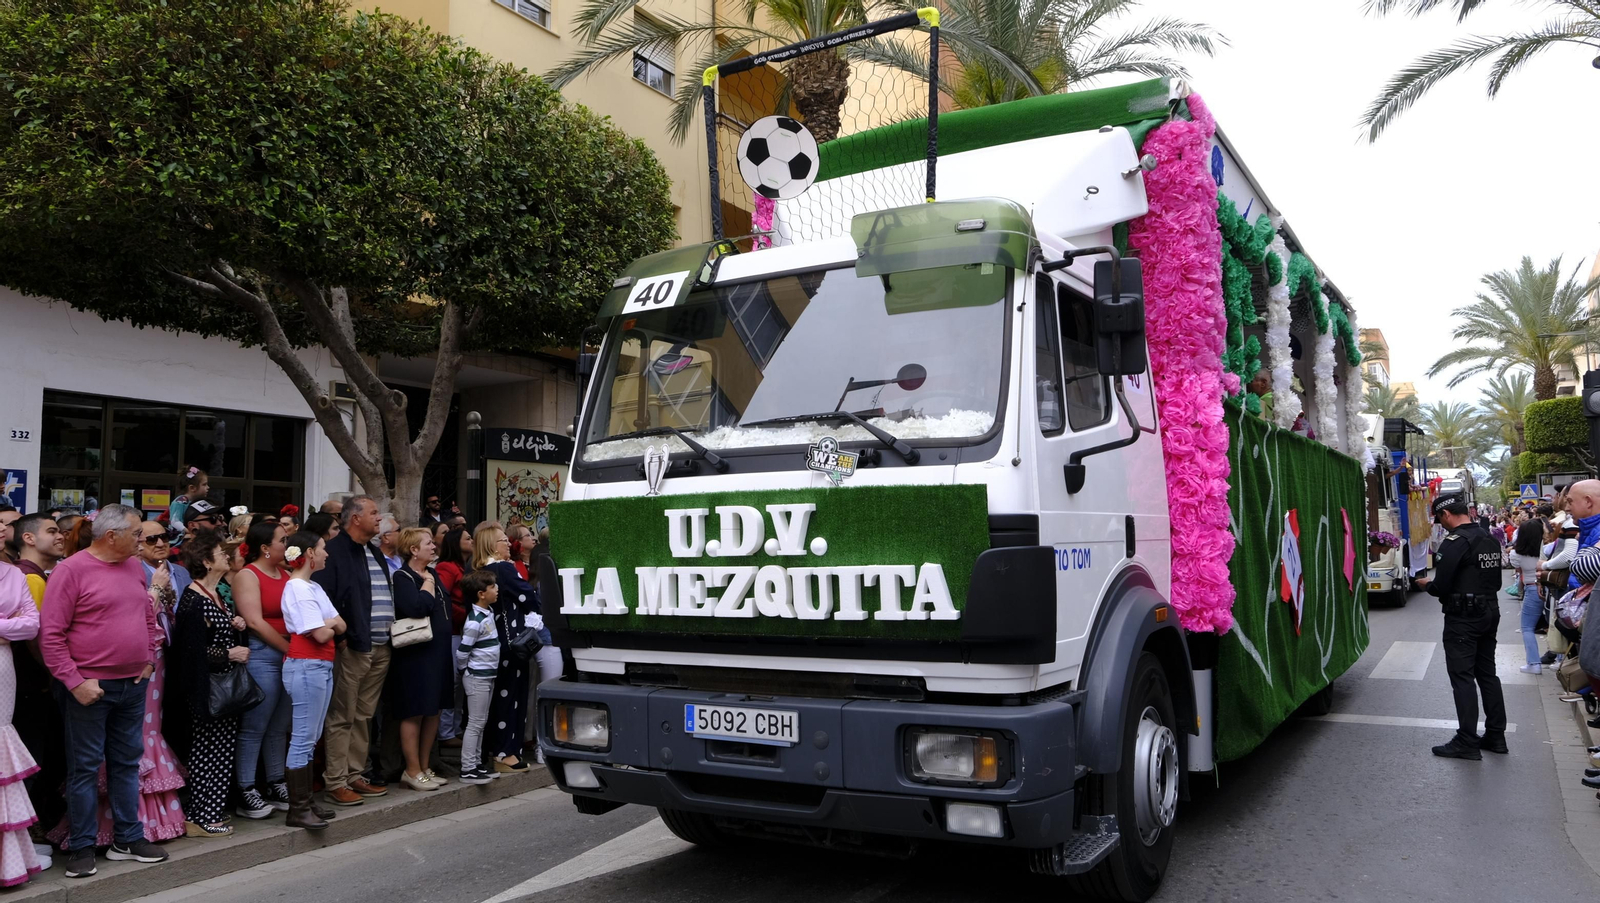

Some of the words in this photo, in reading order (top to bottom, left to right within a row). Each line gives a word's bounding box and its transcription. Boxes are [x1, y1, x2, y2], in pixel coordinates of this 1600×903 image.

[633, 279, 674, 307] 40
[10, 430, 30, 440] 332
[813, 450, 839, 466] WE
[837, 461, 853, 469] THE
[838, 455, 854, 463] ARE
[811, 461, 852, 474] CHAMPIONS
[664, 503, 828, 558] U.D.V.
[1071, 548, 1091, 570] TOM
[1481, 560, 1500, 569] LOCAL
[558, 566, 629, 615] LA
[635, 562, 961, 620] MEZQUITA
[698, 708, 747, 733] 5092
[755, 712, 793, 737] CBH
